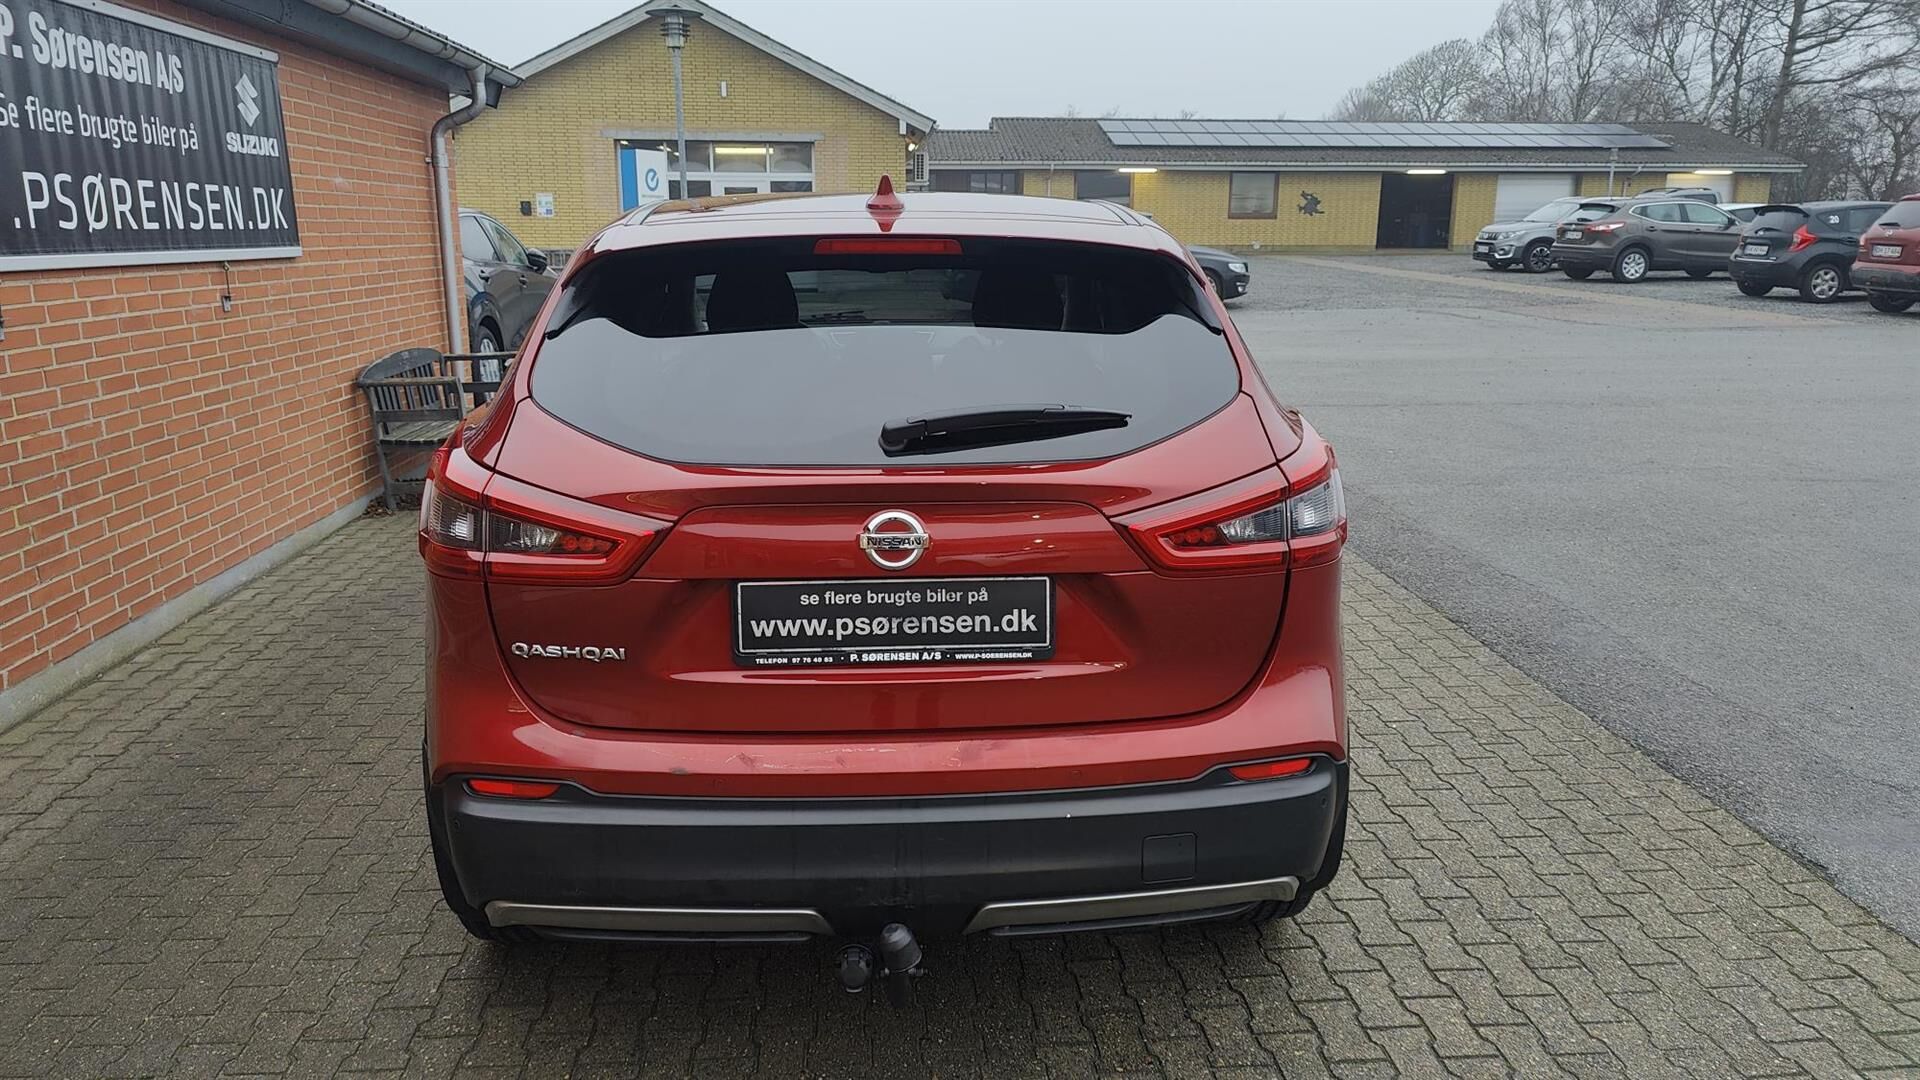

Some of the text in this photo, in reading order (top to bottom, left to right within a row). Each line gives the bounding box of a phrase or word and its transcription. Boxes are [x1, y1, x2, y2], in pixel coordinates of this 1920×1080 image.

[29, 11, 151, 85] Sørensen
[156, 51, 184, 94] A/S
[25, 96, 74, 134] flere
[77, 104, 138, 149] brugte
[141, 115, 177, 147] biler
[179, 123, 199, 155] på
[226, 131, 279, 157] SUZUKI
[866, 535, 922, 547] NISSAN
[800, 587, 989, 606] se flere brugte biler på
[750, 608, 1038, 641] www.psørensen.dk
[511, 642, 626, 662] QASHQAI
[850, 653, 860, 662] P.
[861, 651, 920, 662] SØRENSEN
[922, 651, 943, 661] A/S
